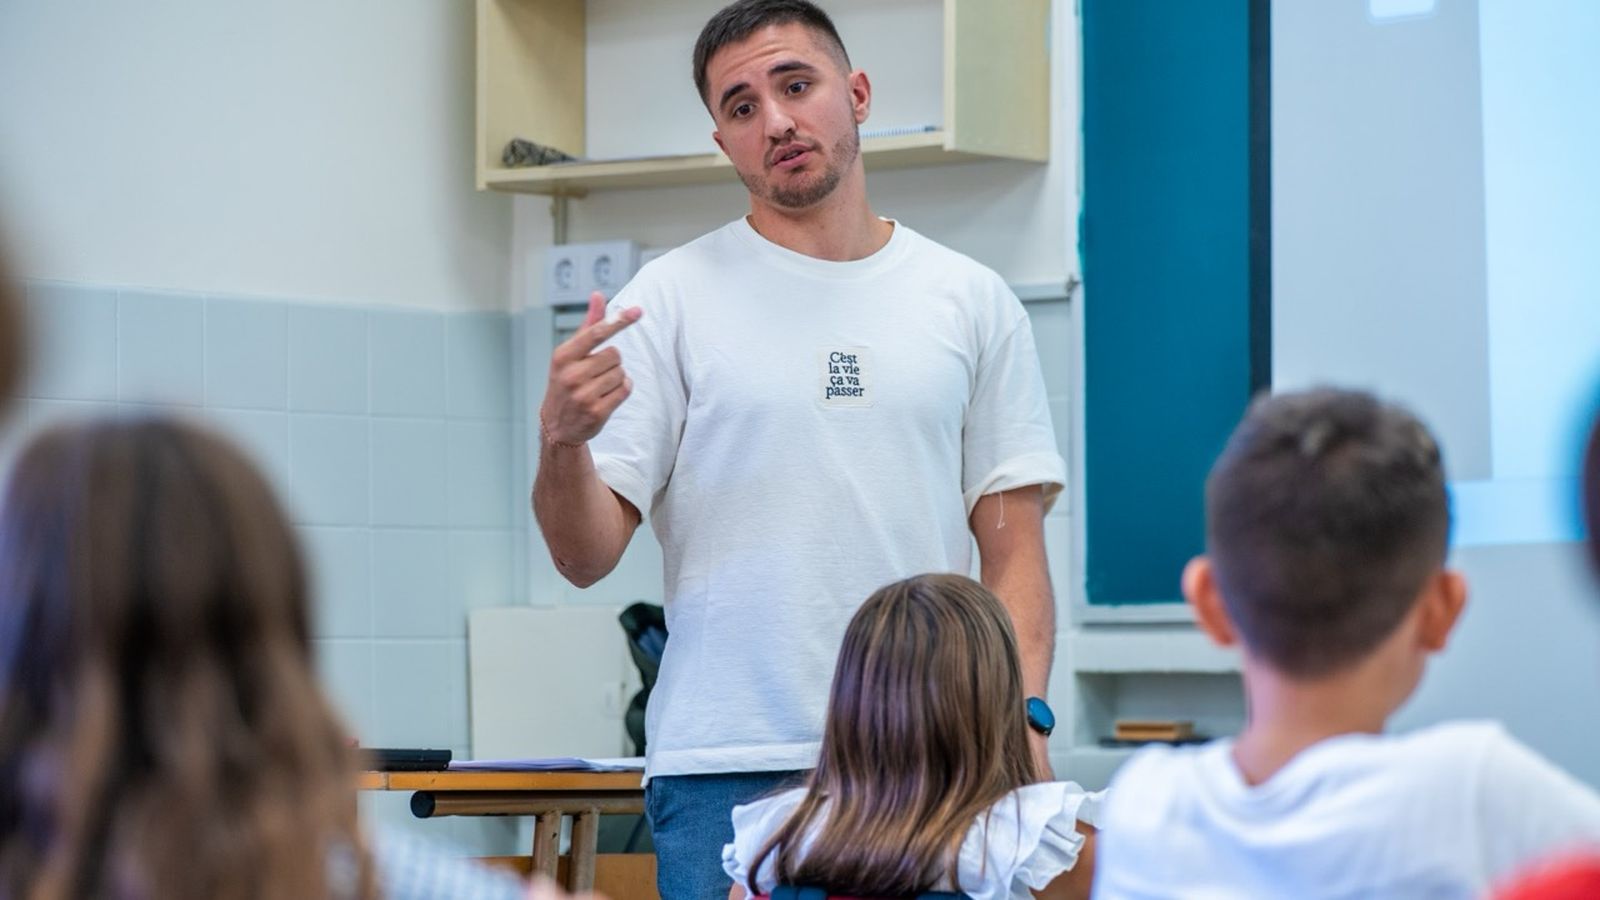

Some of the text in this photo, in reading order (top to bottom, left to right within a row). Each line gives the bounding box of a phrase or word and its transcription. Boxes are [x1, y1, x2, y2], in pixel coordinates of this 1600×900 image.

[828, 362, 860, 375] la vie
[830, 375, 860, 387] ça va
[825, 386, 864, 399] passer
